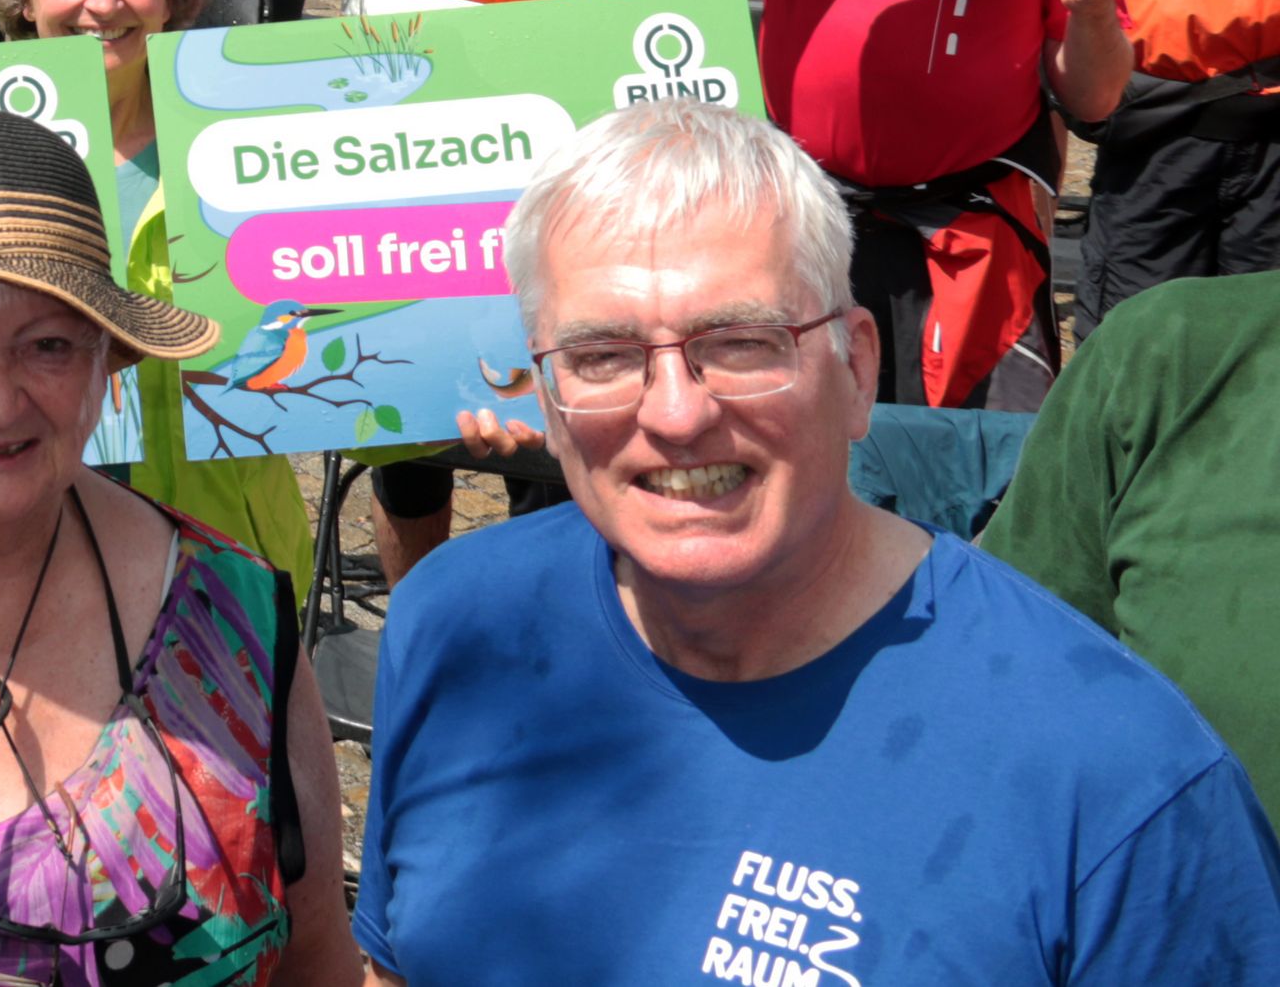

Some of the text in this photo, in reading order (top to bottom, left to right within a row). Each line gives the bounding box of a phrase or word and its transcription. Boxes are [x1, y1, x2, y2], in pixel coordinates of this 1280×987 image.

[233, 123, 533, 185] Die Salzach
[271, 235, 365, 280] soll
[377, 229, 467, 275] frei
[732, 850, 862, 922] FLUSS.
[717, 893, 809, 954] FREI.
